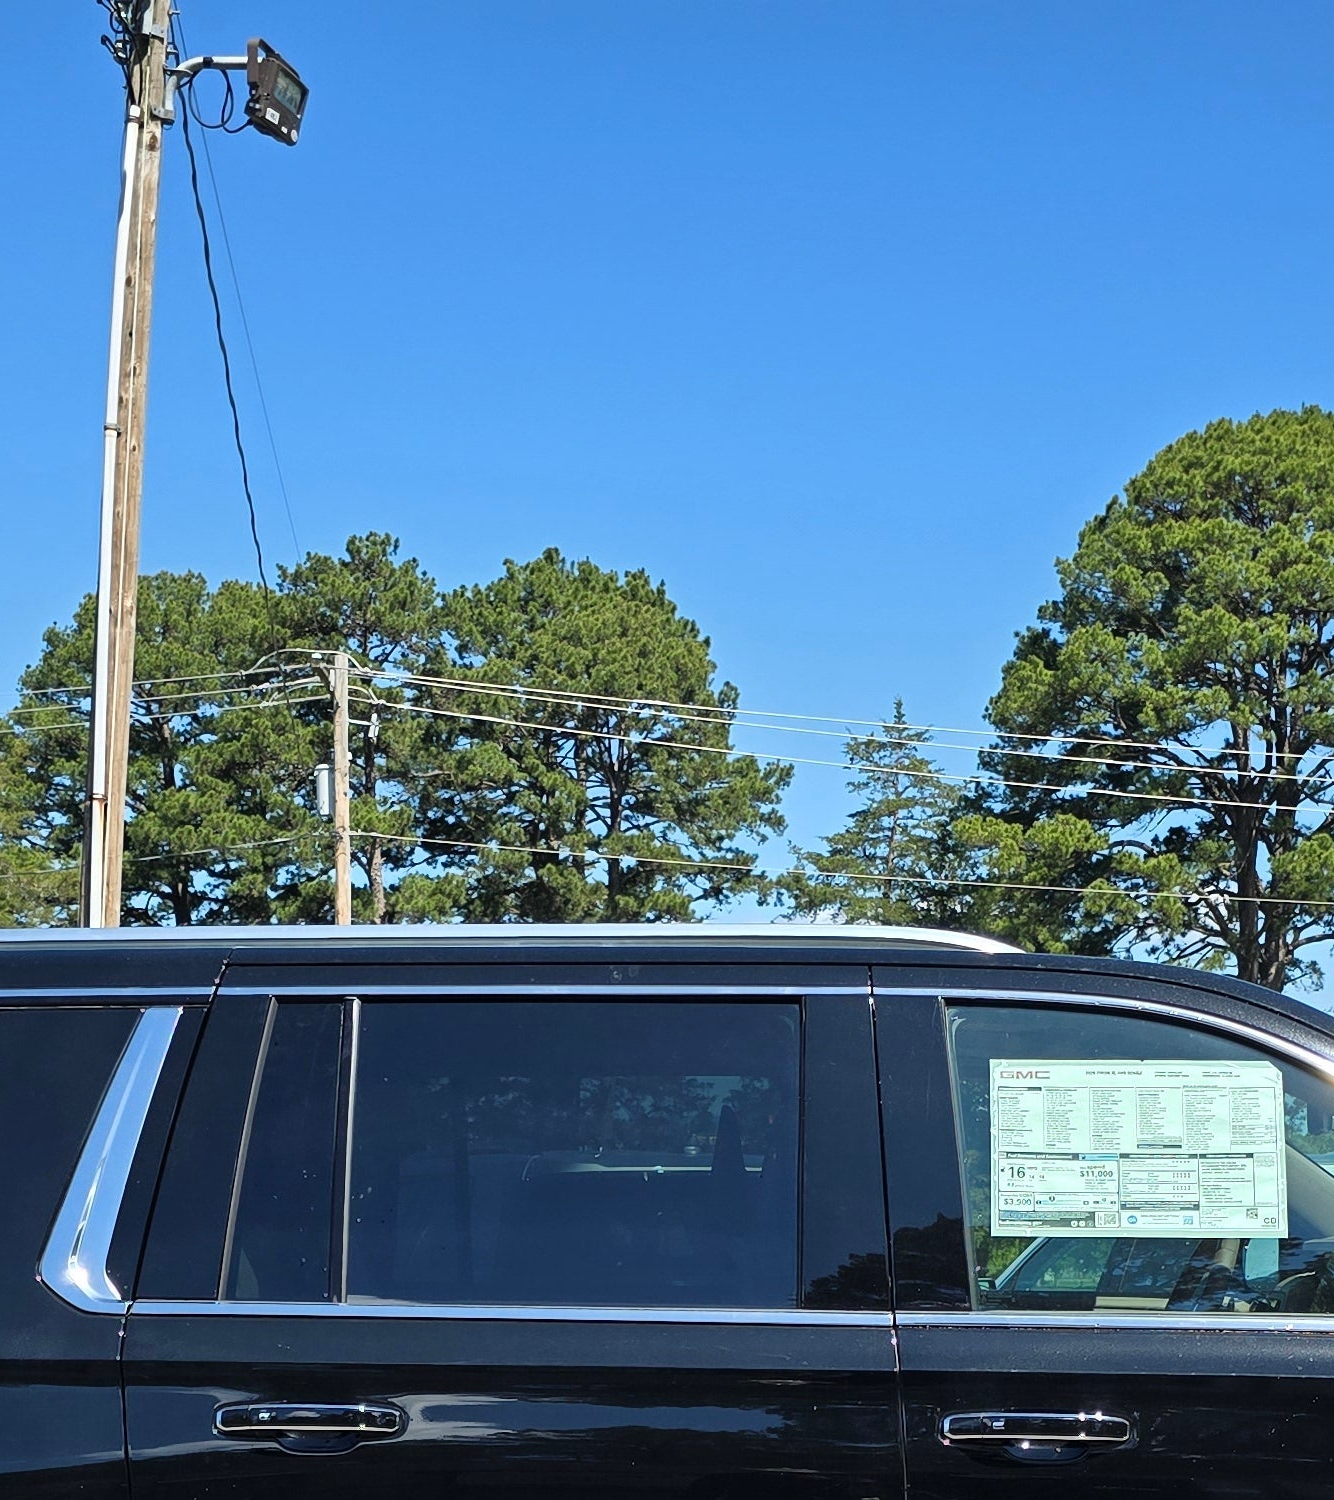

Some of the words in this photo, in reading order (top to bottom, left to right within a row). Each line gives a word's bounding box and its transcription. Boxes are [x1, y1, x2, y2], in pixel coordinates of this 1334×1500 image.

[1000, 1070, 1050, 1079] GMC
[1008, 1166, 1026, 1179] 16
[1079, 1170, 1113, 1178] $11,000
